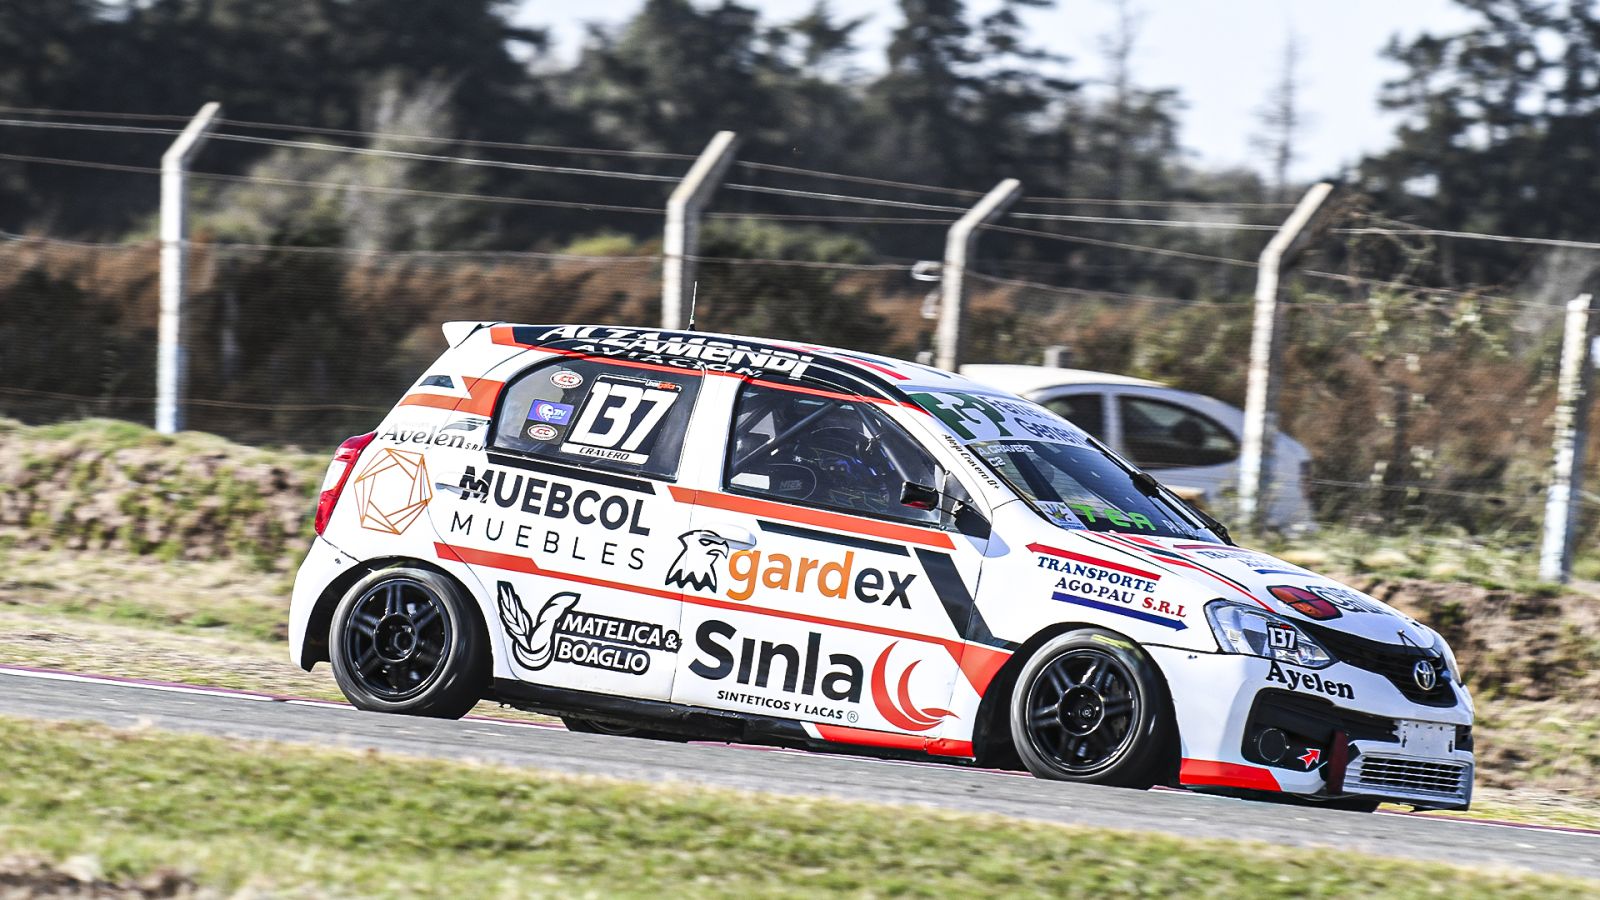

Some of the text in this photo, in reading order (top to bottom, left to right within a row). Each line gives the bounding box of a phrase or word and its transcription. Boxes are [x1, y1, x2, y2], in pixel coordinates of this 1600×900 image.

[568, 381, 679, 451] 137
[379, 423, 466, 449] Ayelen
[987, 444, 1035, 455] CRAVERO
[579, 446, 630, 461] CRAVERO
[459, 465, 651, 537] MUEBCOL
[1070, 503, 1157, 531] TEA
[450, 510, 645, 570] MUEBLES
[726, 549, 917, 610] gardex
[1037, 556, 1157, 593] TRANSPORTE
[1055, 577, 1136, 604] AGO-PAU
[561, 613, 679, 649] MATELICA &
[1268, 627, 1296, 649] 137
[558, 641, 648, 672] BOAGLIO
[1265, 660, 1355, 700] Ayelen
[717, 690, 791, 712] SINTETICOS
[794, 702, 802, 713] Y
[804, 704, 843, 720] LACAS
